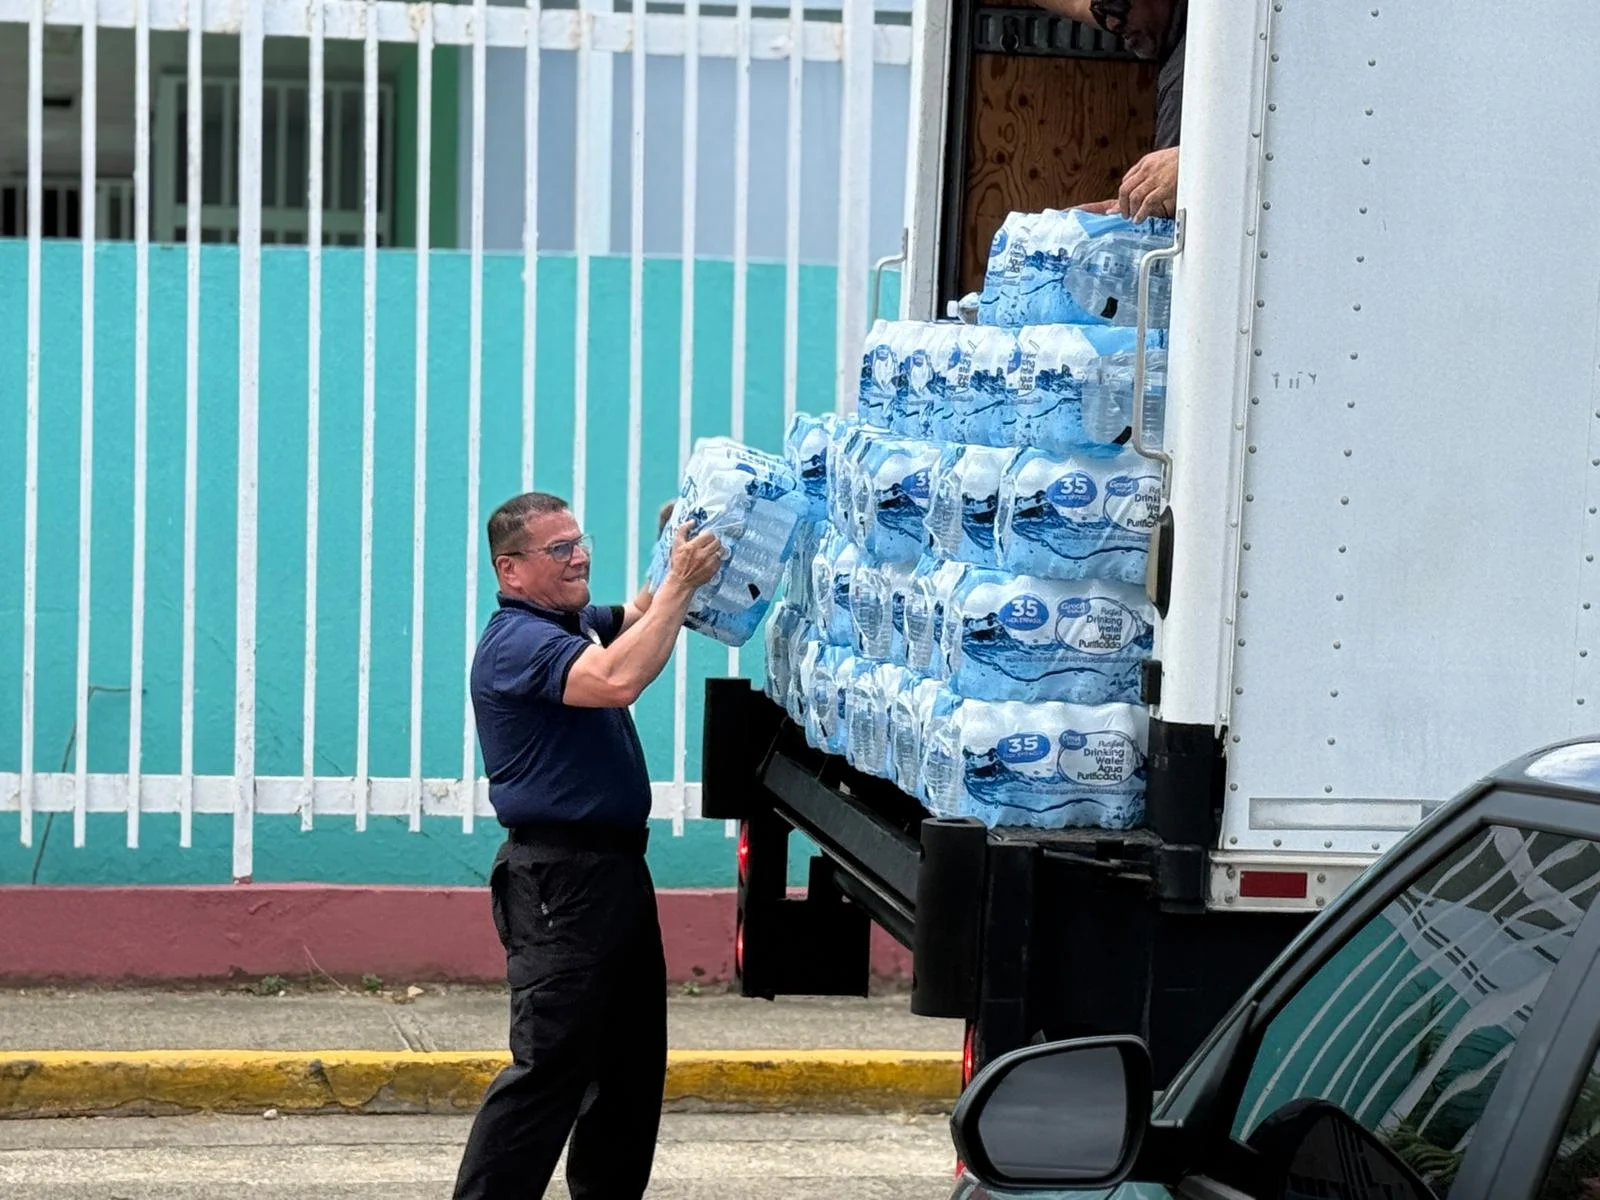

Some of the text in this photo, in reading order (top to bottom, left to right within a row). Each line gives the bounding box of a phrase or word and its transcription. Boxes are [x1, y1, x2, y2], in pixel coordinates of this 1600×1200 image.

[915, 471, 927, 486] 3
[1060, 477, 1088, 494] 35
[1011, 599, 1038, 617] 35
[1086, 615, 1123, 626] Drinking
[1098, 624, 1123, 633] Water
[1100, 632, 1121, 642] Agua
[1079, 639, 1122, 649] Purificada
[1008, 736, 1038, 753] 35
[1084, 748, 1124, 757] Drinking
[1096, 756, 1124, 765] Water
[1097, 764, 1123, 773] Agua
[1077, 771, 1123, 781] Purificada
